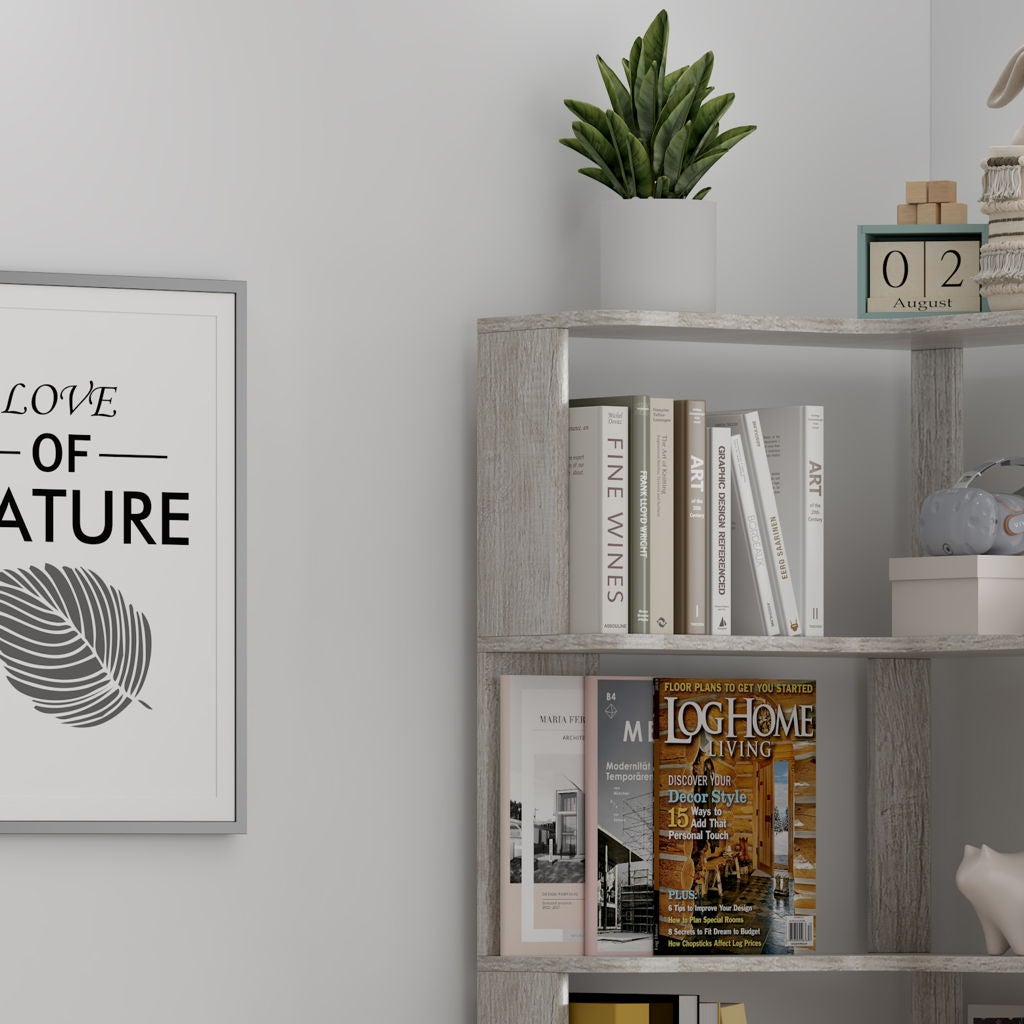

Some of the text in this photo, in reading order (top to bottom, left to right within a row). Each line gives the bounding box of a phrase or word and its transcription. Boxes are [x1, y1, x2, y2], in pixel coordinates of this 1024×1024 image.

[893, 298, 952, 310] August
[1, 380, 118, 417] LOVE
[32, 432, 91, 473] OF
[607, 438, 624, 498] FINE
[690, 455, 704, 492] ART
[718, 445, 726, 490] GRAPHIC
[809, 460, 822, 496] ART
[0, 486, 190, 546] ATURE
[640, 470, 648, 558] FRANK LLOYD WRIGHT
[718, 493, 726, 528] DESIGN
[607, 512, 624, 603] WINES
[769, 515, 789, 580] EERO SAARINEN
[718, 531, 726, 596] REFERENCED
[664, 682, 813, 694] FLOOR PLANS TO GET YOU STARTED
[540, 716, 566, 724] MARIA
[708, 740, 772, 758] LIVING
[668, 775, 732, 786] DISCOVER YOUR
[668, 789, 747, 807] Decor Style
[668, 807, 689, 828] 15
[691, 807, 712, 817] Ways
[690, 818, 726, 828] Add That
[668, 830, 729, 840] Personal Touch
[668, 890, 698, 900] PLUS:
[734, 905, 752, 913] Design
[741, 928, 760, 936] Budget
[732, 940, 742, 948] Log
